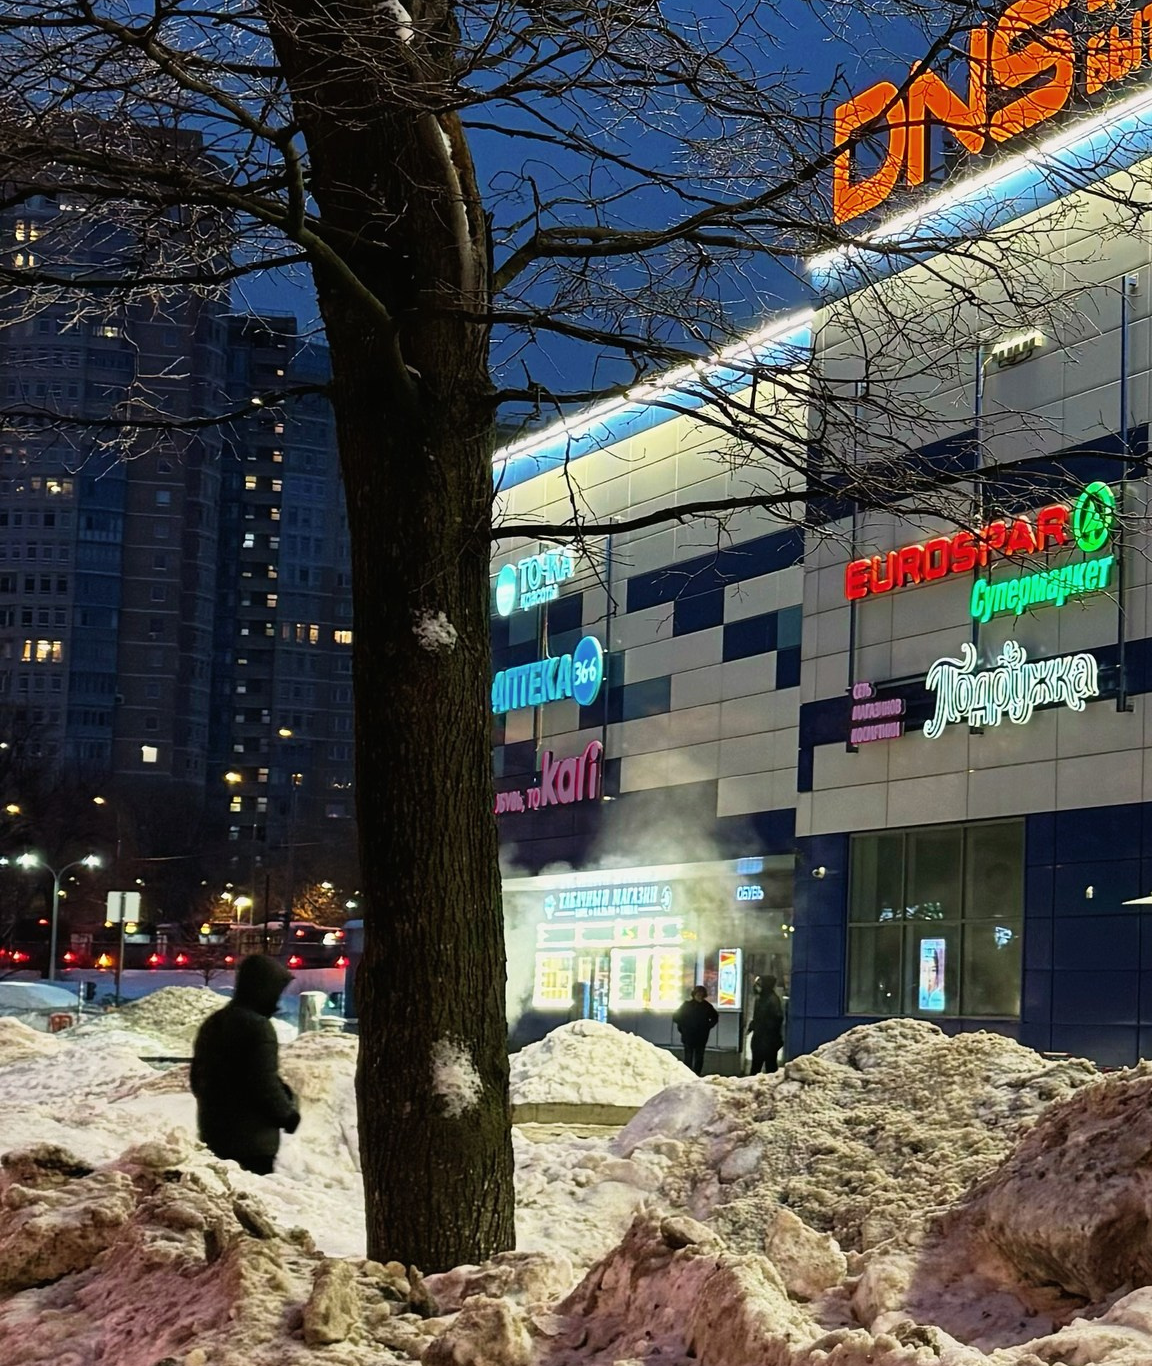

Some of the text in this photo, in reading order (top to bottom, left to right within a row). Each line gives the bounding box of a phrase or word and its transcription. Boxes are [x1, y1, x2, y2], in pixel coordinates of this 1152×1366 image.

[518, 544, 576, 593] ТОЧКА
[844, 503, 1072, 601] EUROSPAR
[969, 555, 1115, 624] Супермаркет
[491, 653, 573, 715] АПТЕКА
[923, 640, 1099, 739] Подружка
[541, 741, 603, 807] kari
[736, 885, 765, 901] ОБУВЬ
